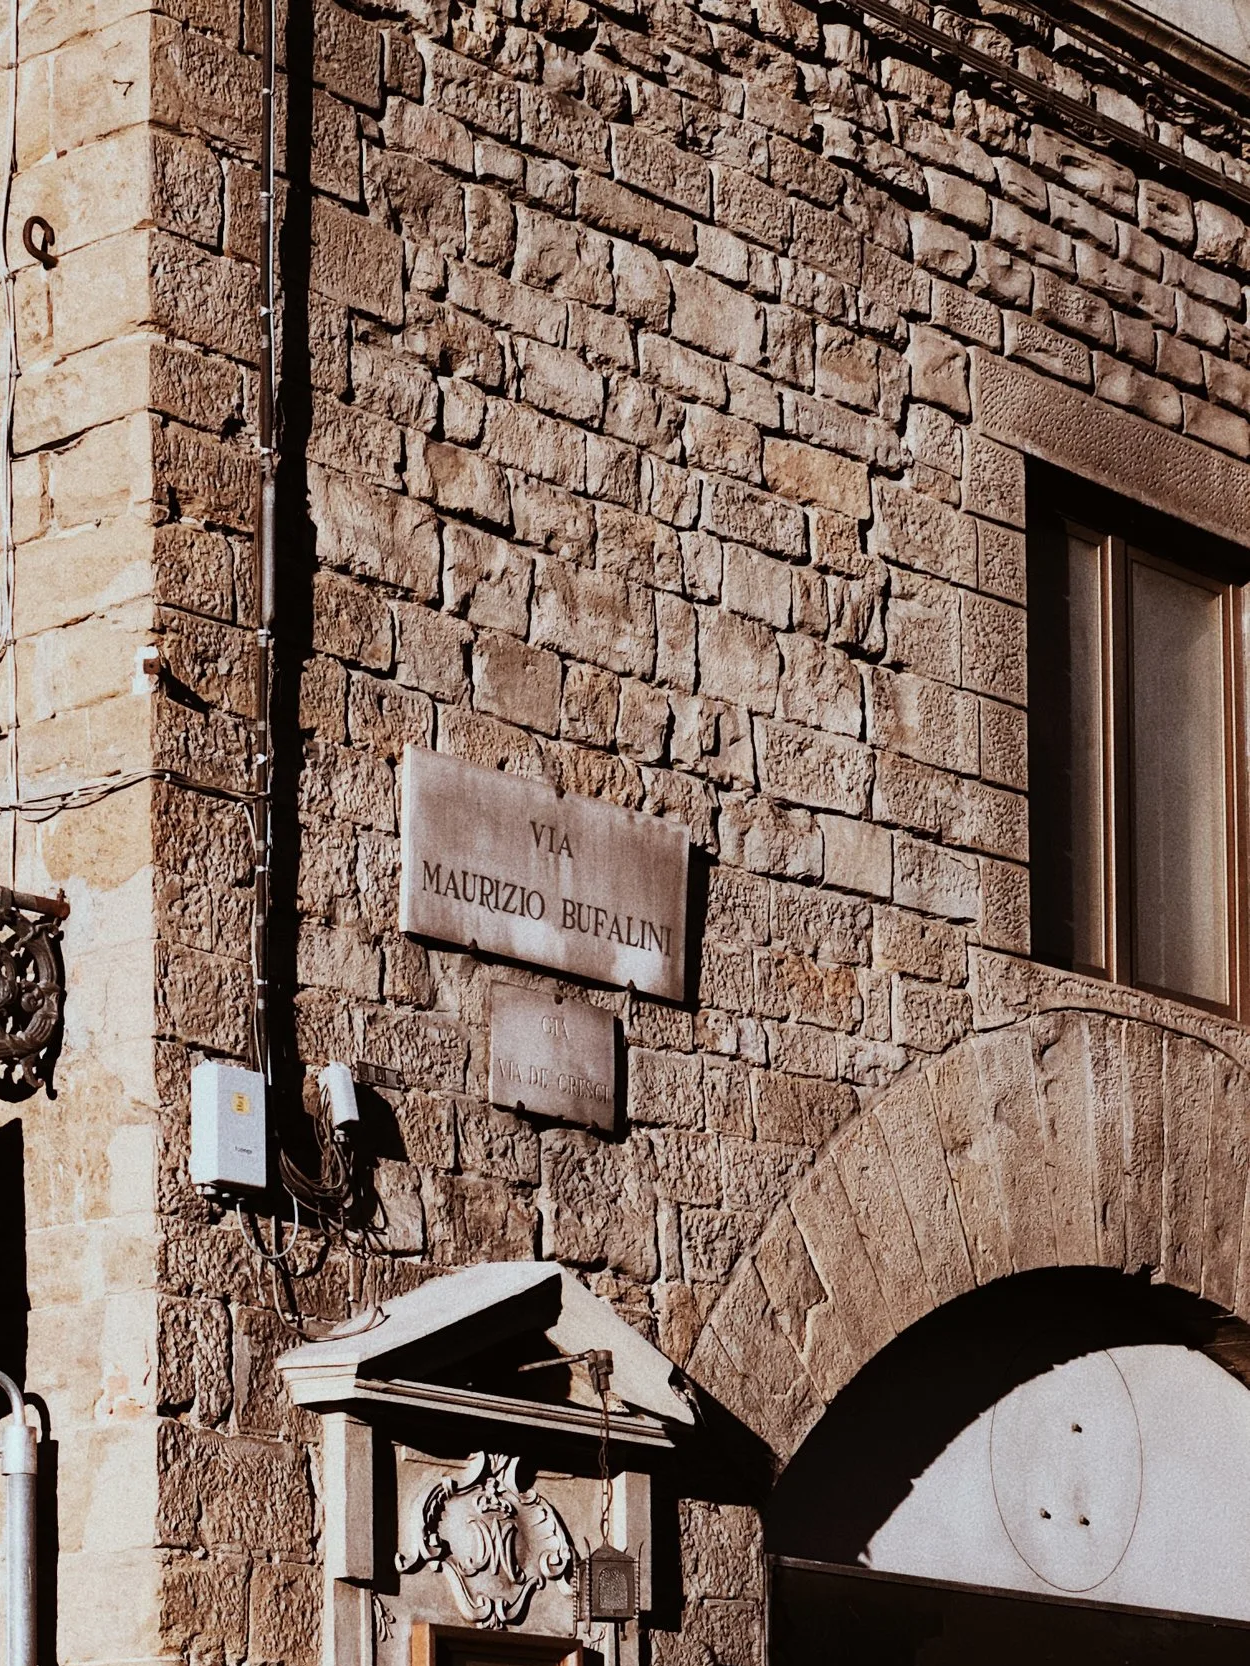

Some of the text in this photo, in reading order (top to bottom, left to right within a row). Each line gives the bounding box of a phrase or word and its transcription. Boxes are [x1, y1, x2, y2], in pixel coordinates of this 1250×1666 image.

[529, 820, 574, 859] VIA
[422, 860, 673, 957] MAURIZIO BUFALINI
[497, 1058, 523, 1083] VIA
